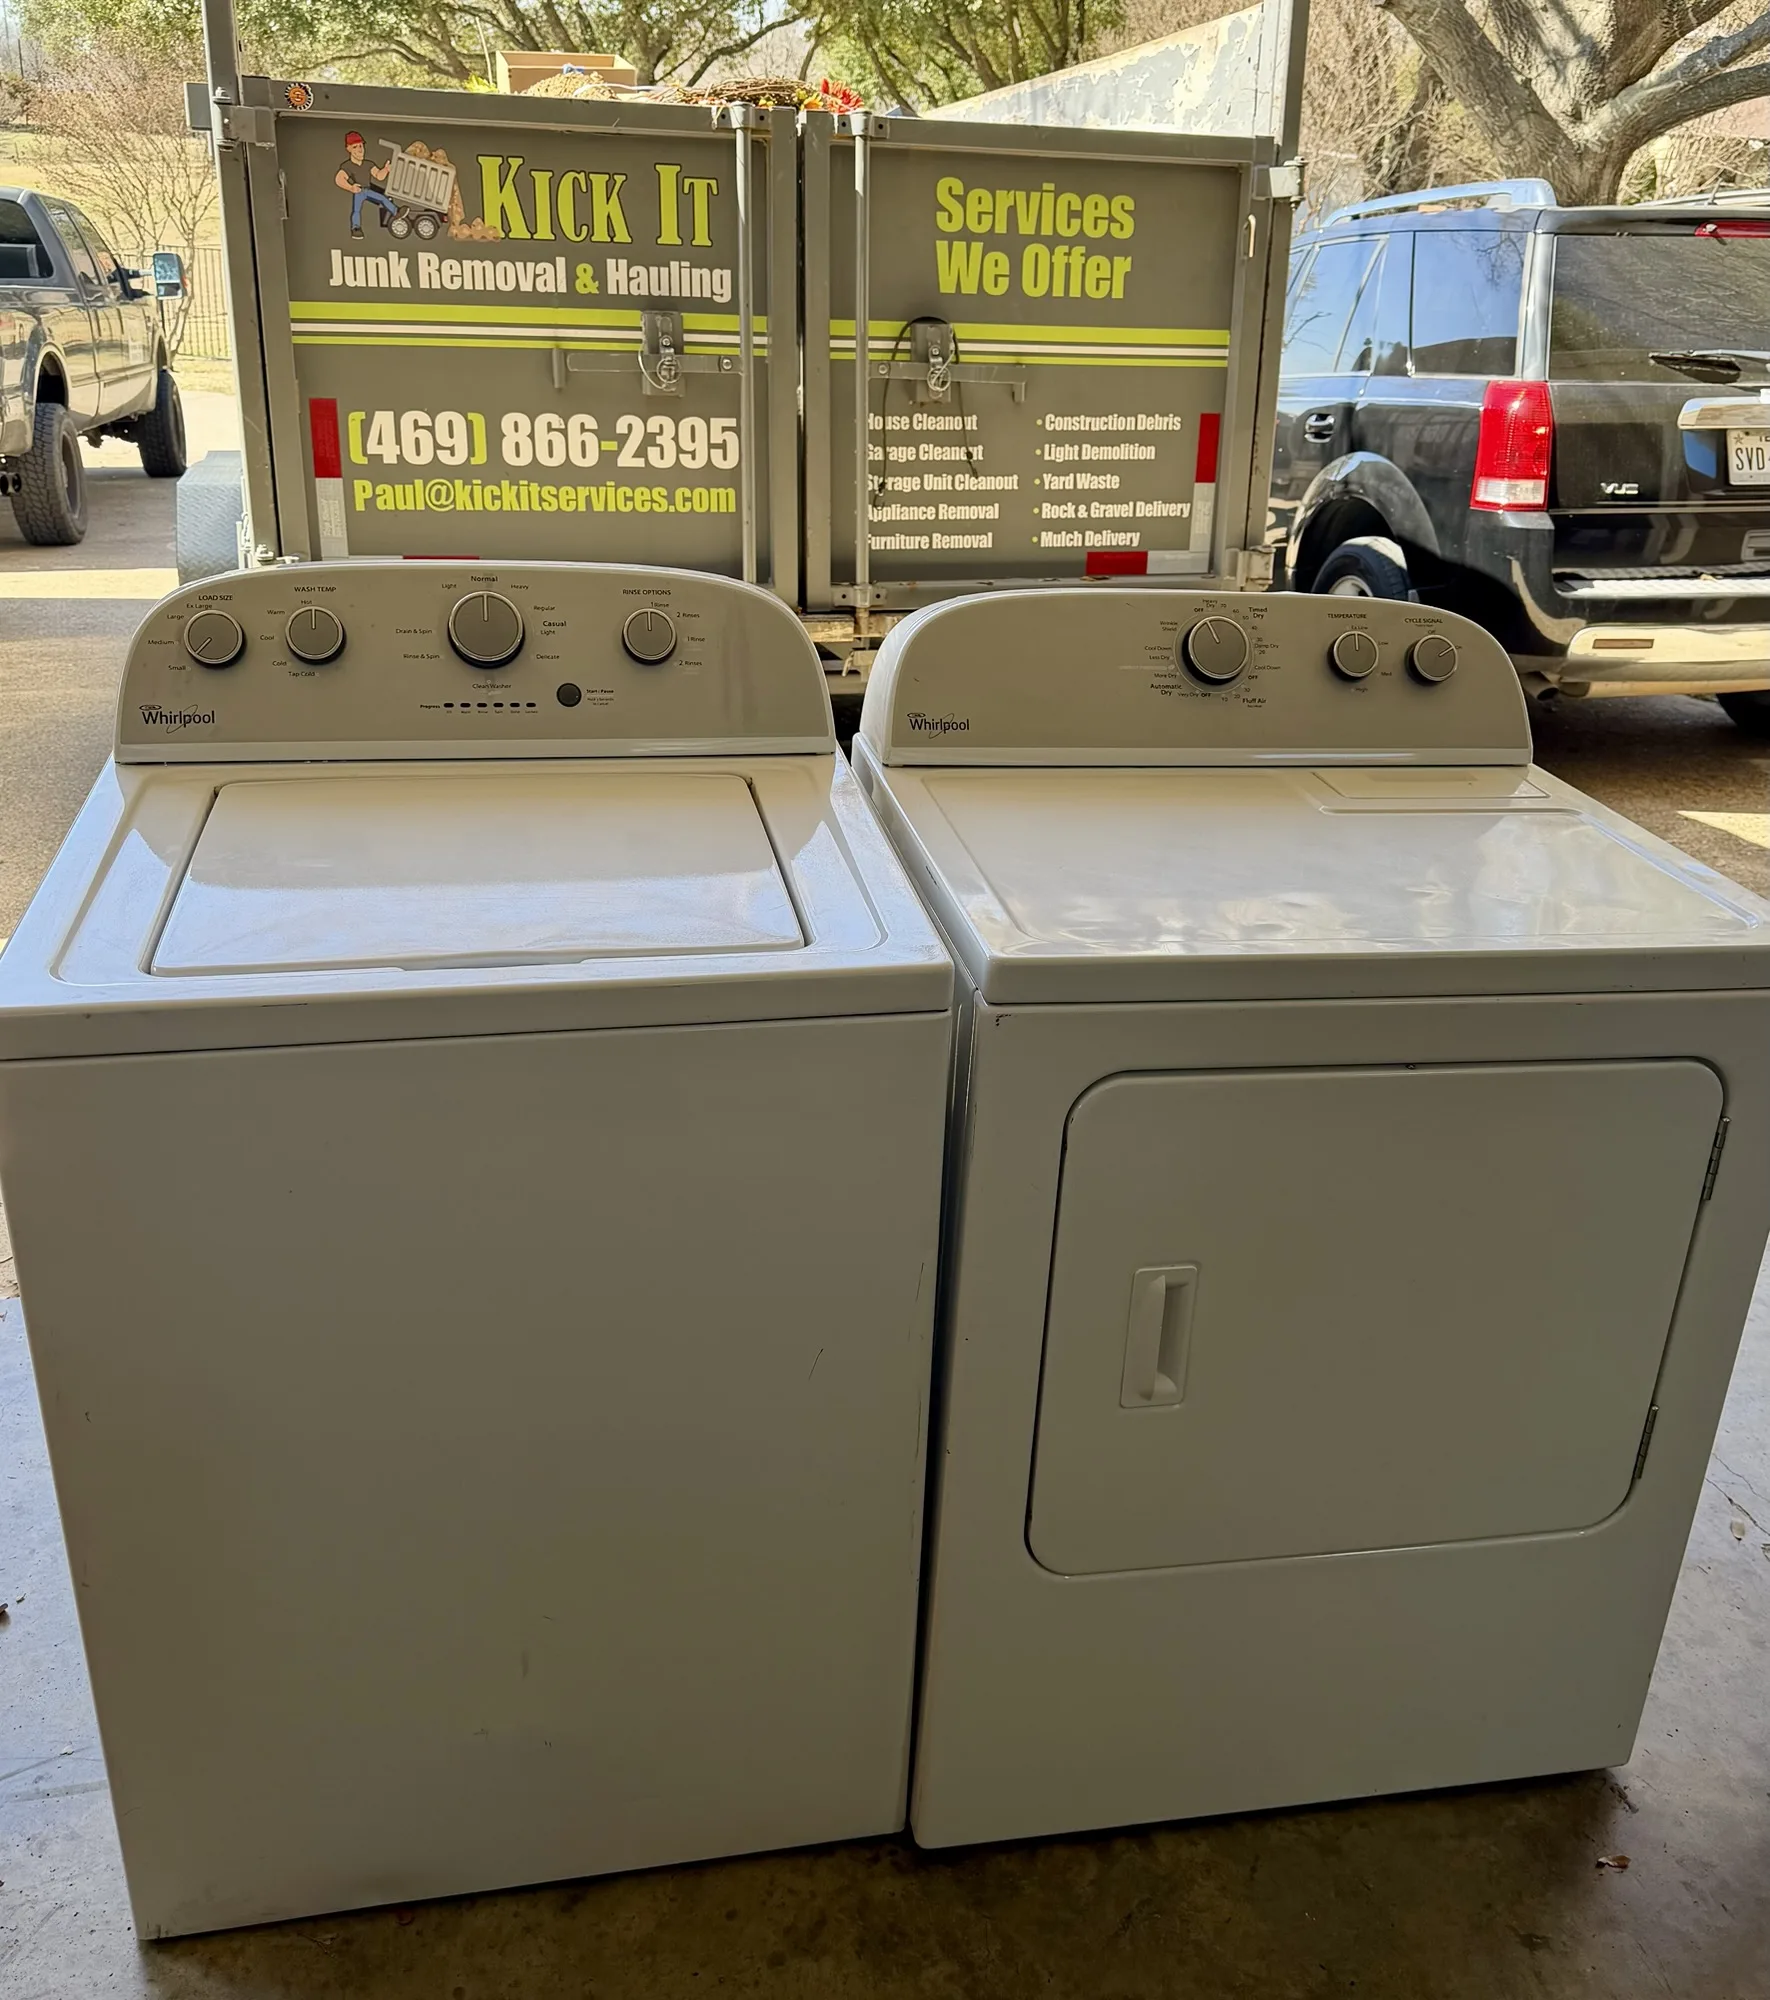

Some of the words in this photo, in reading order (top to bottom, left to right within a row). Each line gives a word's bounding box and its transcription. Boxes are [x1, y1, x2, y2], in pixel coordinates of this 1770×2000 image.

[476, 155, 631, 244] KICK
[654, 162, 718, 247] IT
[936, 176, 1135, 240] Services
[330, 249, 411, 289] Junk
[419, 252, 566, 293] Removal
[575, 263, 600, 294] &
[606, 258, 732, 302] Hauling
[935, 240, 1010, 295] We
[1021, 243, 1132, 299] Offer
[912, 412, 978, 431] Cleanout
[1045, 413, 1135, 431] Construction
[1137, 413, 1181, 431] Debris
[501, 413, 739, 469] 866-2395
[1043, 444, 1079, 462] Light
[1081, 443, 1156, 460] Demolition
[923, 473, 953, 491] Unit
[954, 473, 1019, 491] Cleanout
[1043, 473, 1074, 490] Yard
[1076, 473, 1120, 489] Waste
[353, 478, 736, 514] Paul@kickitservices.com
[938, 503, 999, 520] Removal
[1041, 502, 1076, 519] Rock
[1078, 504, 1088, 518] &
[1090, 501, 1133, 518] Gravel
[1135, 501, 1191, 518] Delivery
[932, 532, 993, 549] Removal
[1040, 531, 1082, 547] Mulch
[1085, 530, 1140, 547] Delivery
[142, 710, 215, 728] Whirlpool
[909, 718, 969, 734] Whirlpool
